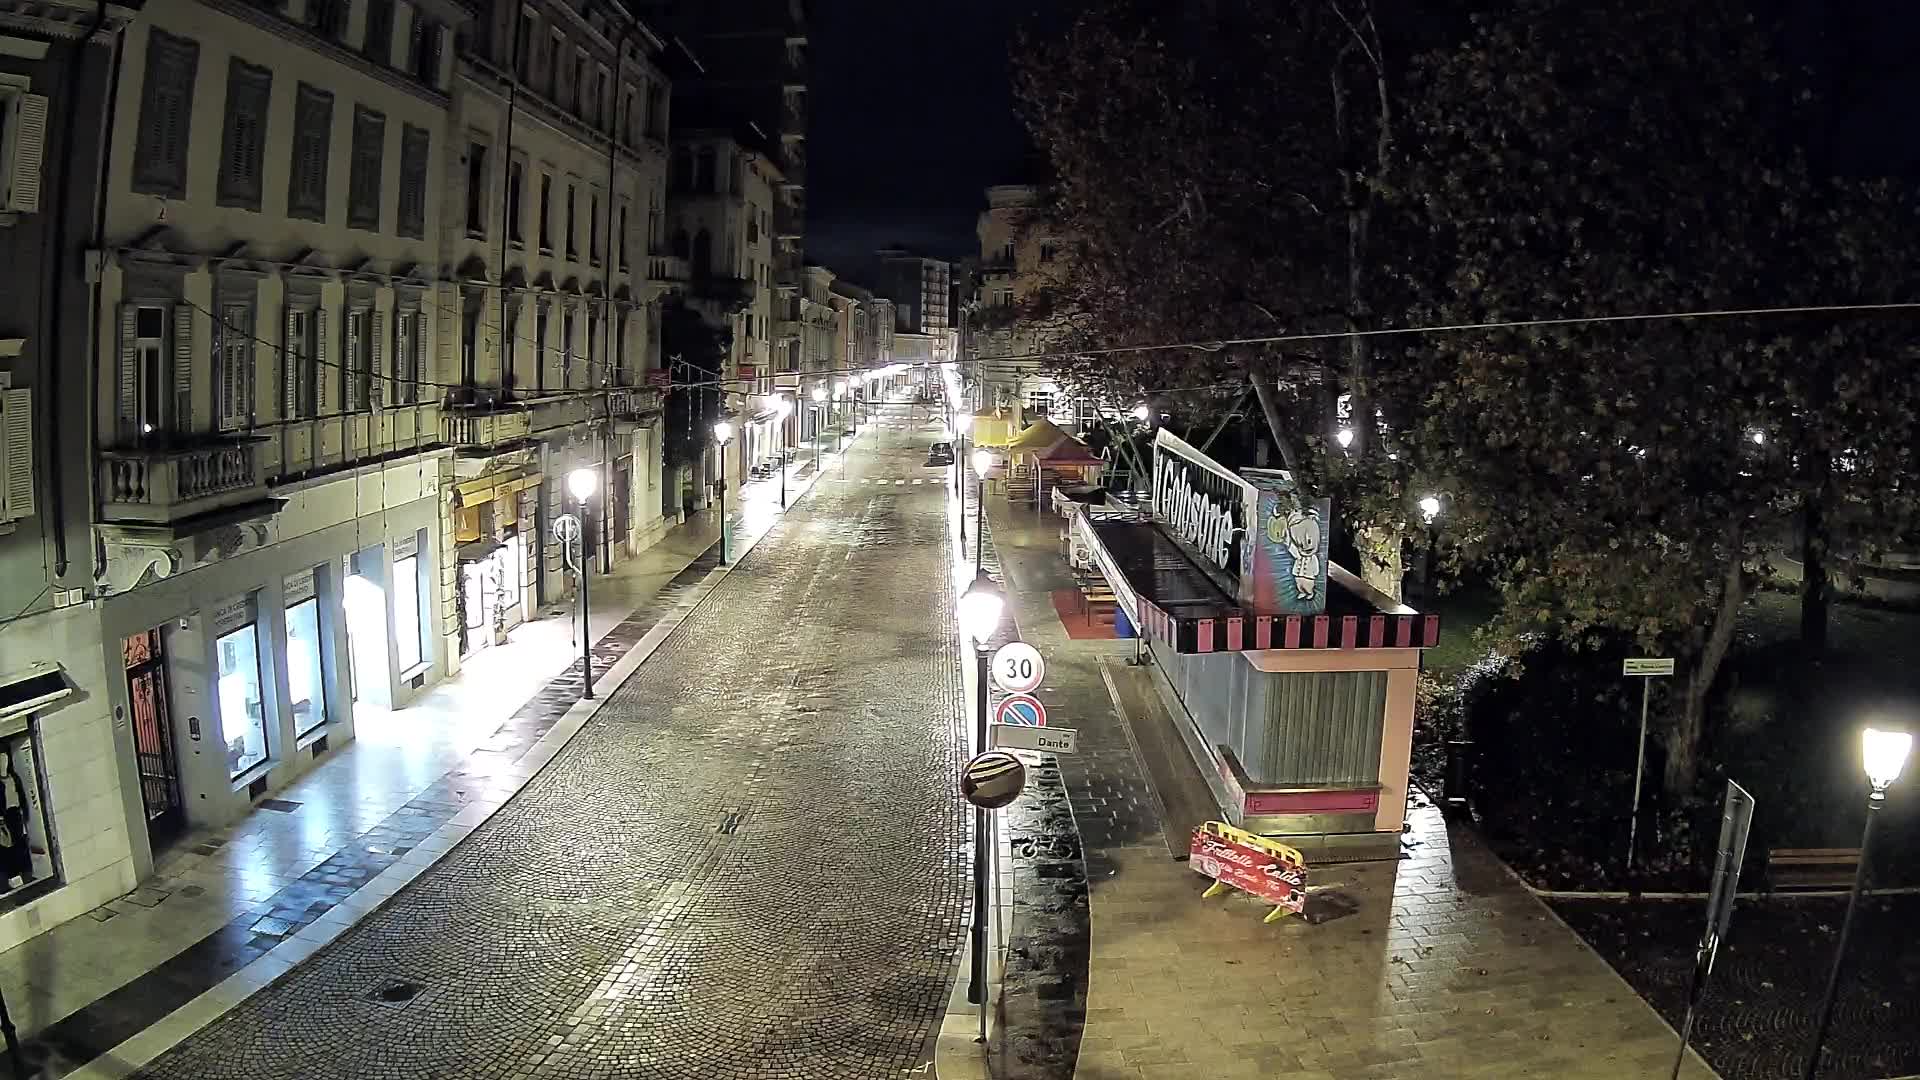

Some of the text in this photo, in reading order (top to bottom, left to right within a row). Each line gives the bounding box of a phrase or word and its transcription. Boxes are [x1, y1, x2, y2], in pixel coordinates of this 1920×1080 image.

[1161, 458, 1233, 570] Golosone
[1006, 658, 1032, 679] 30
[1038, 737, 1070, 749] Dante
